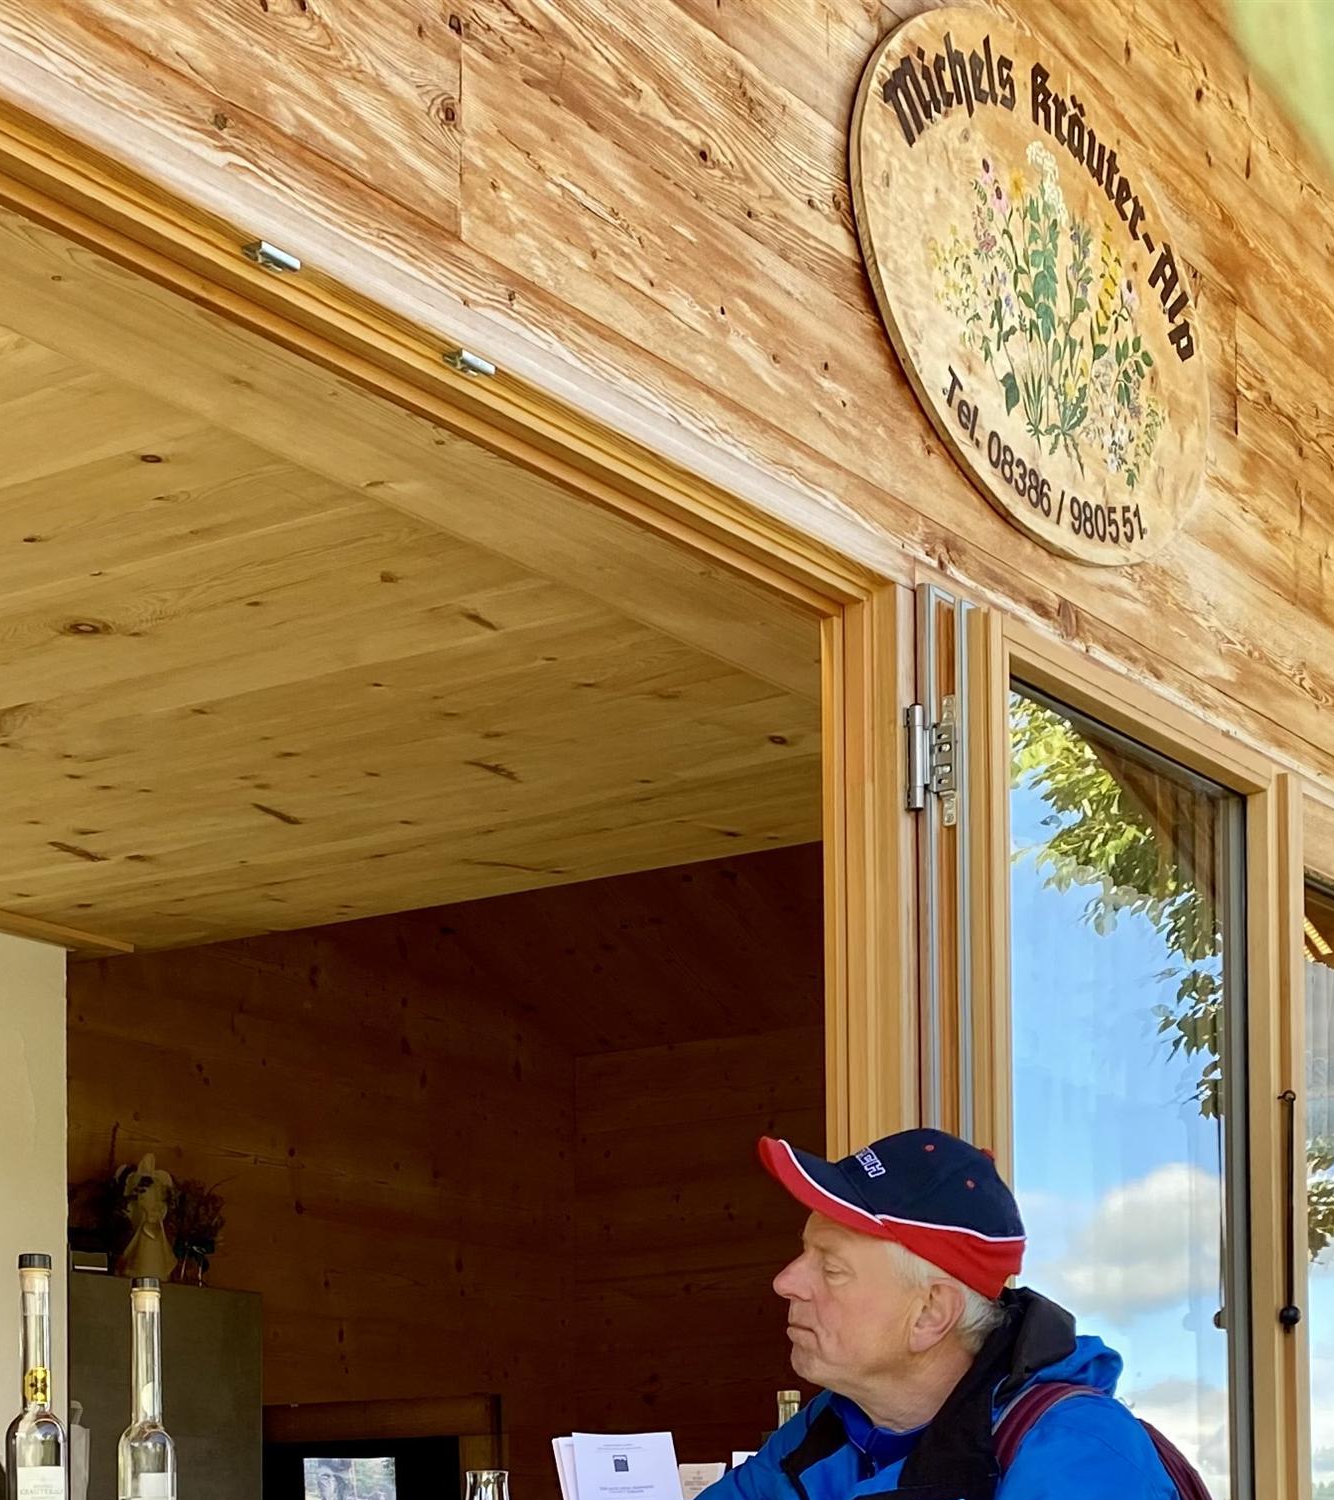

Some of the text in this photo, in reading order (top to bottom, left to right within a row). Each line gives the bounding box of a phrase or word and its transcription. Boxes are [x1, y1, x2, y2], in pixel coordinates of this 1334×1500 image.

[883, 33, 1194, 362] Michels Kräuter-Alp
[946, 365, 981, 451] Tel.
[987, 431, 1052, 516] 08386
[1070, 498, 1144, 544] 980551
